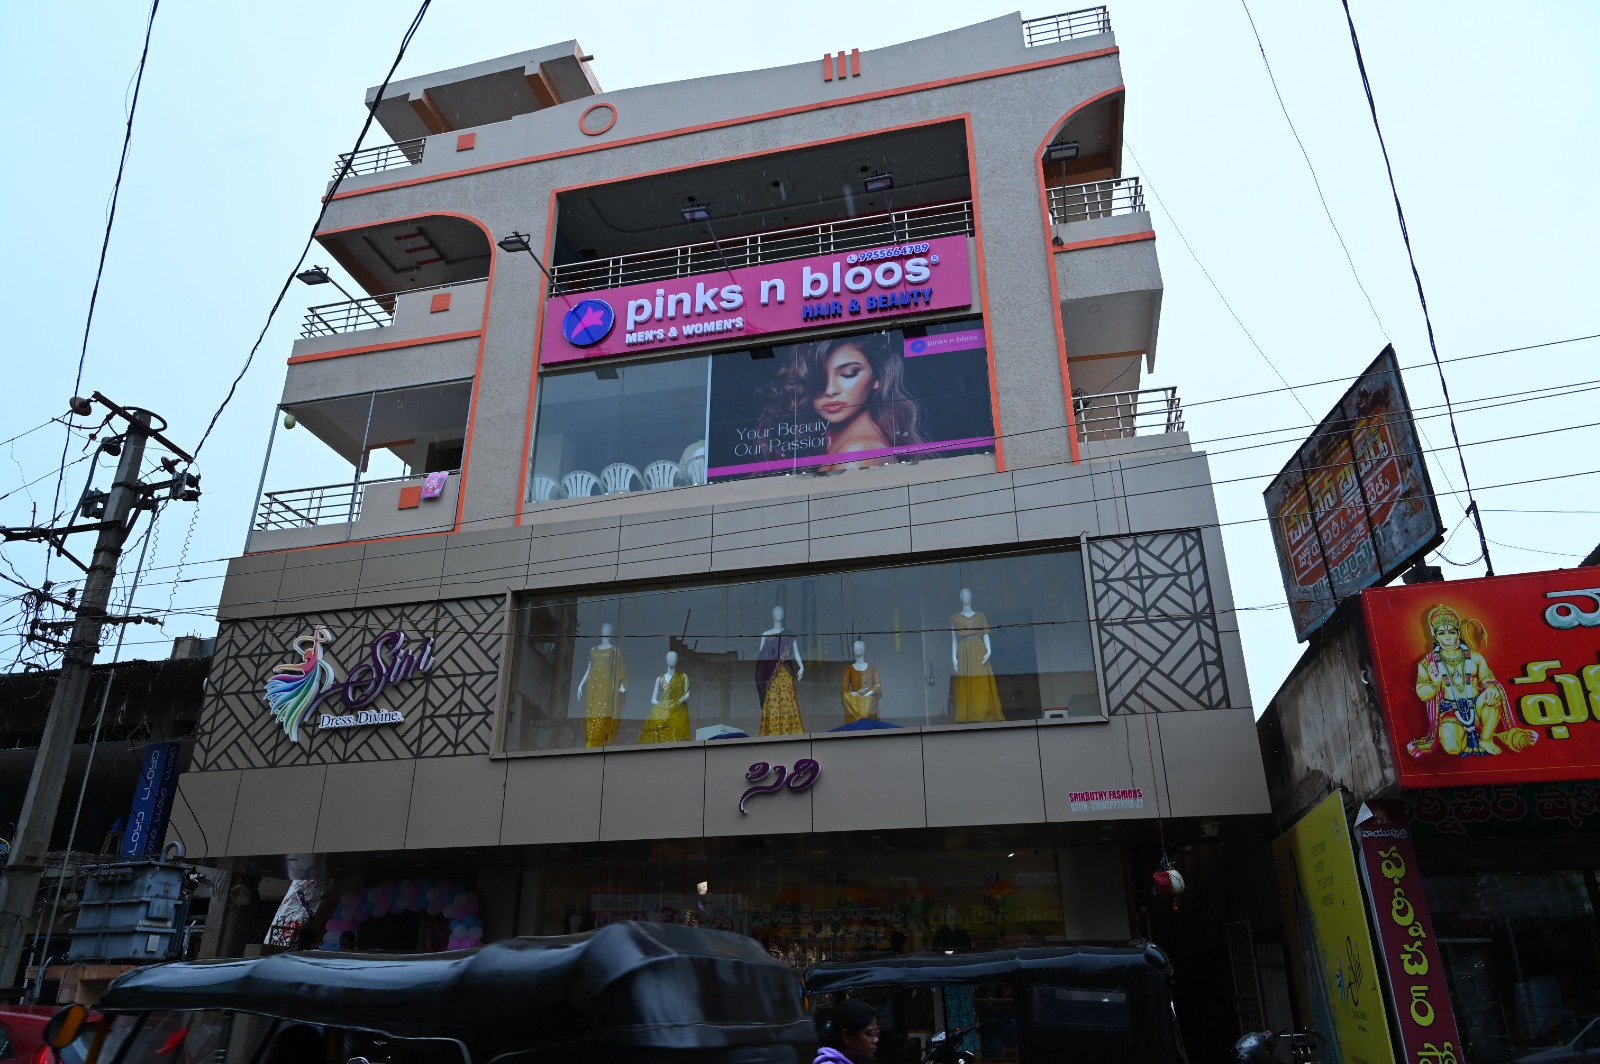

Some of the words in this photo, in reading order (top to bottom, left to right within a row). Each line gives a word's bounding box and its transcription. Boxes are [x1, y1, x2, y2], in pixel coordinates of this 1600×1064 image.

[859, 243, 929, 262] 9955664789
[626, 282, 744, 332] pinks
[760, 278, 786, 305] n
[802, 257, 931, 299] bloos
[802, 300, 842, 321] HAIR
[848, 298, 861, 314] &
[867, 287, 932, 312] BEAUTY
[625, 328, 665, 346] MEN'S
[668, 326, 679, 339] &
[682, 316, 744, 337] WOMEN'S
[927, 338, 948, 348] pinks
[736, 427, 775, 440] Your
[734, 442, 766, 456] Our
[769, 435, 832, 453] Passion
[1108, 788, 1143, 800] FASHIONS
